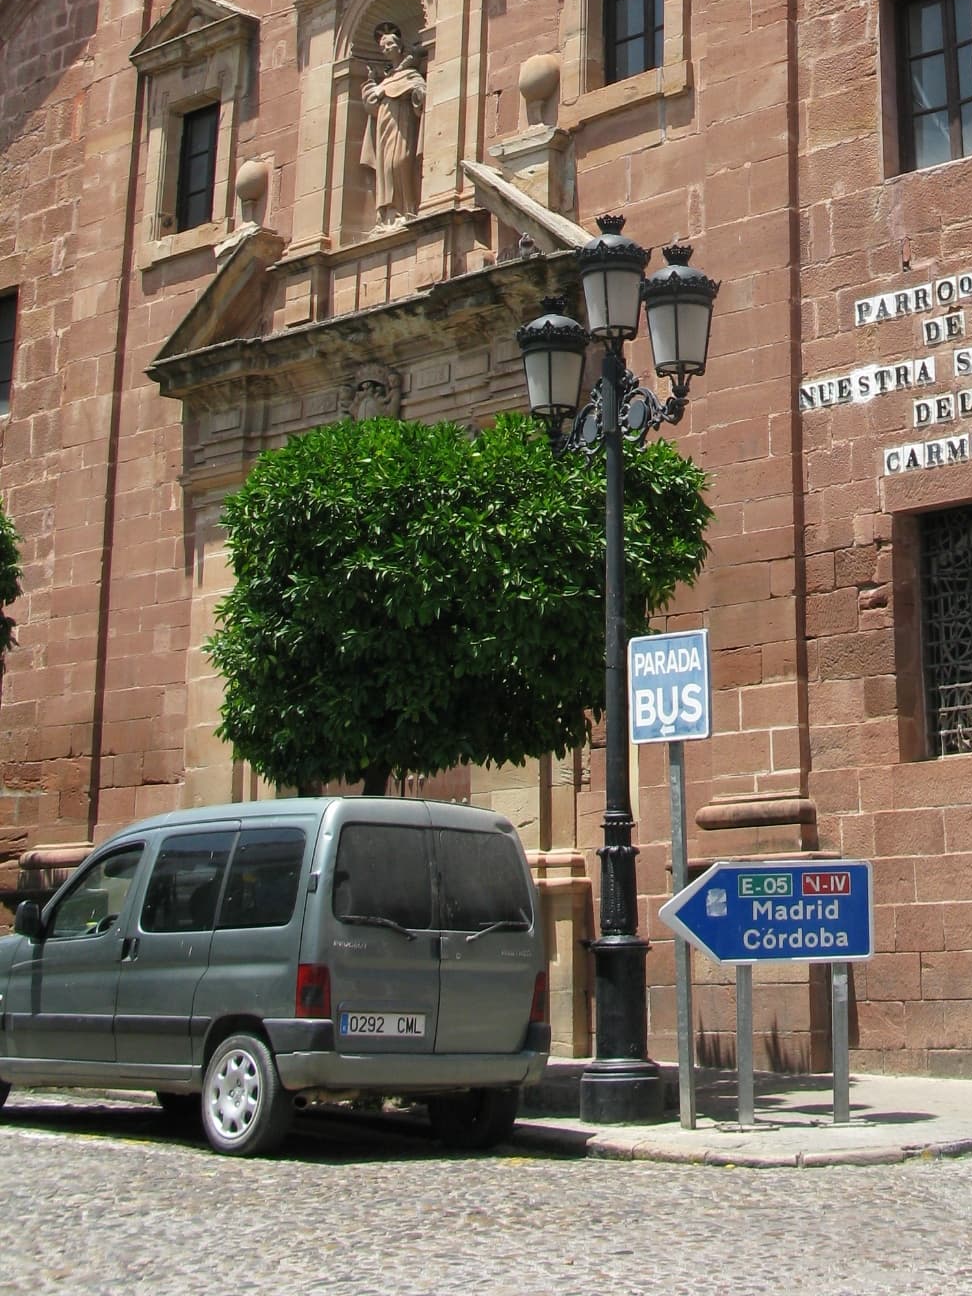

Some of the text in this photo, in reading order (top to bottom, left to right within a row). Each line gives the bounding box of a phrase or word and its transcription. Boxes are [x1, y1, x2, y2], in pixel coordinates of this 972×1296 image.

[925, 314, 963, 342] DE
[800, 360, 935, 408] NUESTRA
[634, 647, 701, 677] PARADA
[635, 683, 703, 727] BUS
[752, 899, 839, 921] Madrid
[743, 927, 849, 950] Córdoba
[350, 1016, 385, 1033] 0292
[397, 1017, 422, 1034] CML
